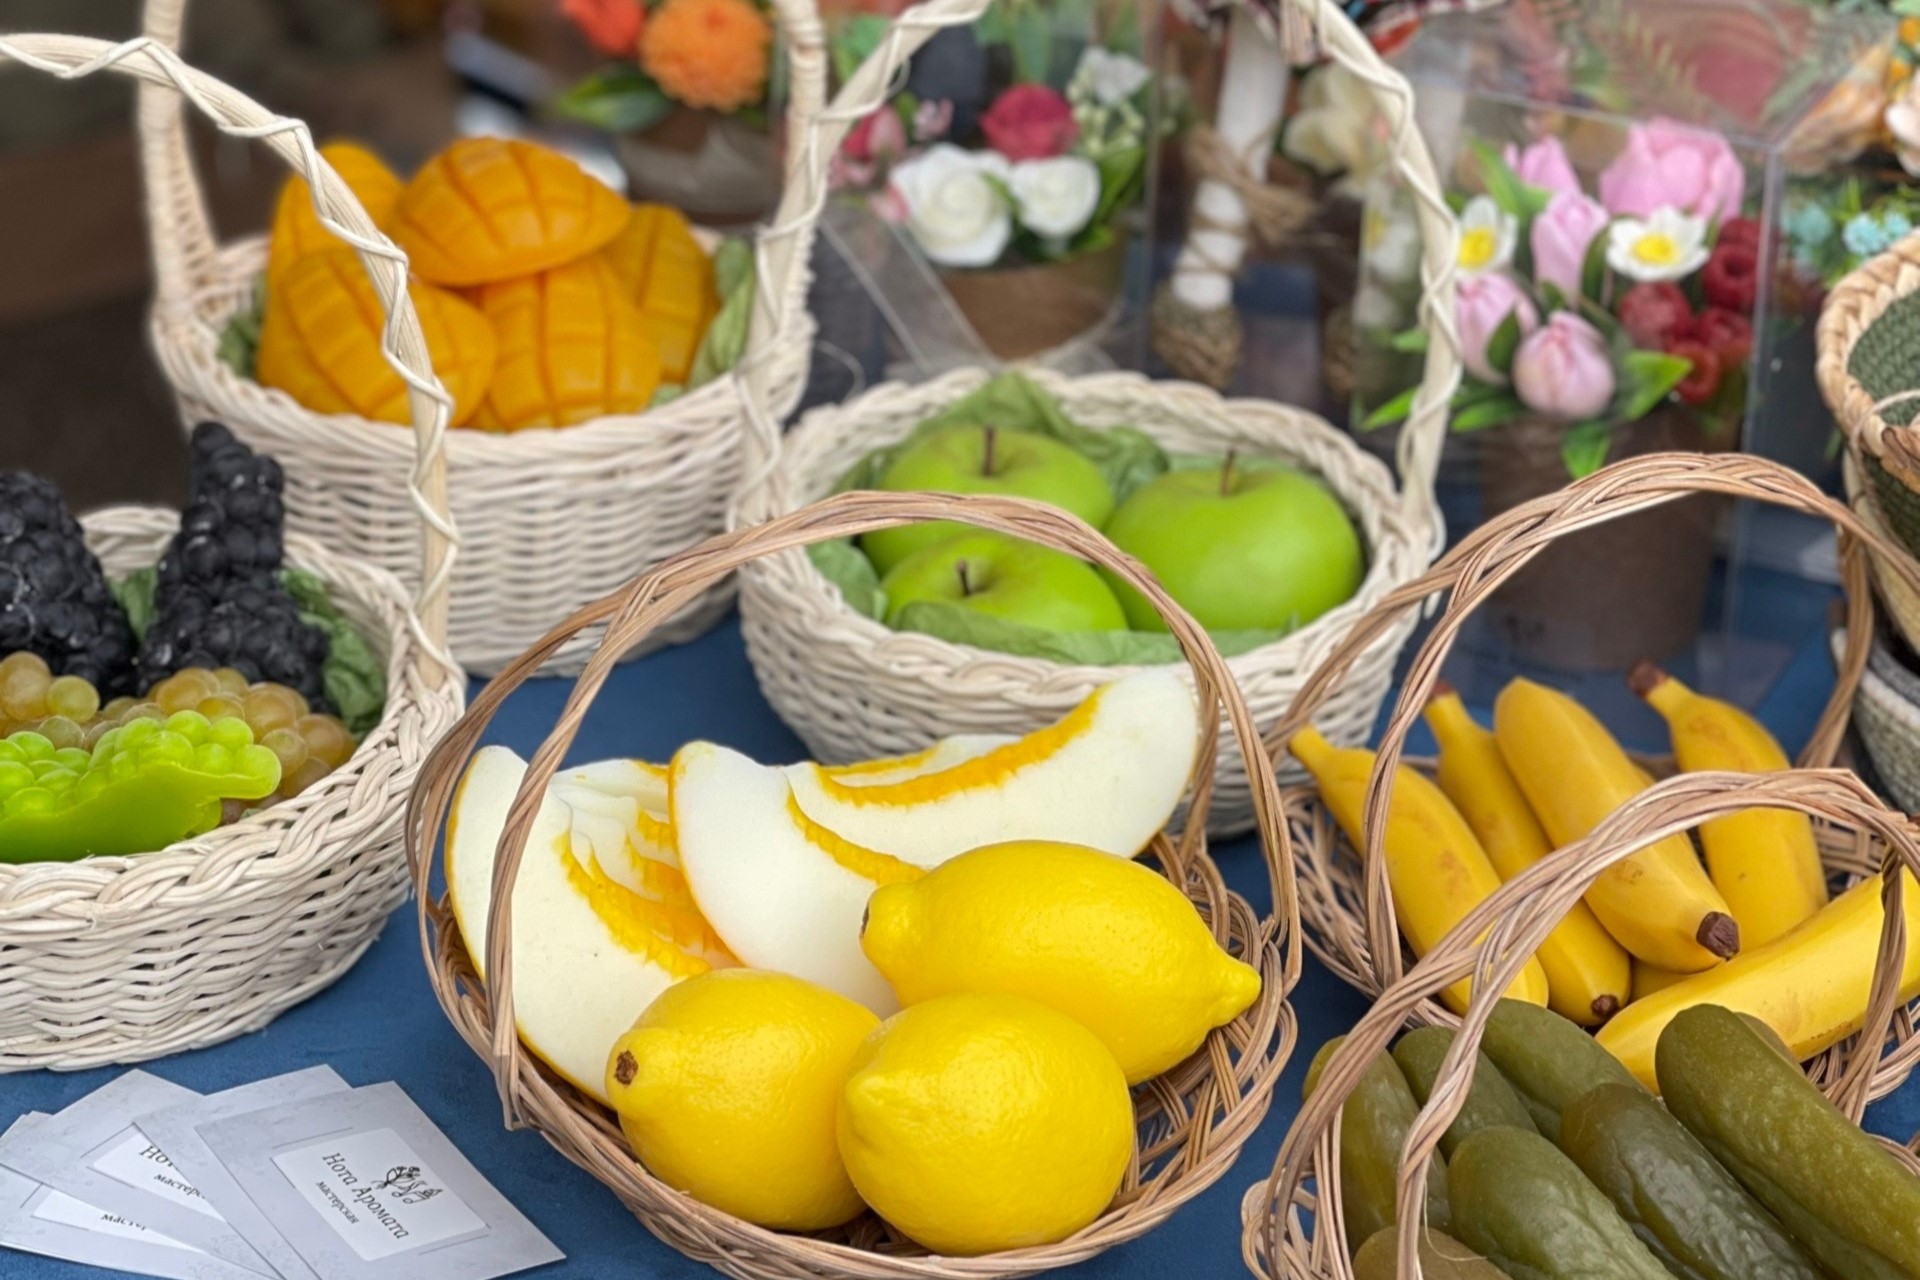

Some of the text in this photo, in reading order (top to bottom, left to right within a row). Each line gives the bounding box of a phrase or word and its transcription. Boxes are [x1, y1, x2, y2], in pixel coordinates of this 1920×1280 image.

[153, 1174, 205, 1199] мастер
[316, 1181, 359, 1224] мастерская
[322, 1153, 409, 1239] Нота Аромата
